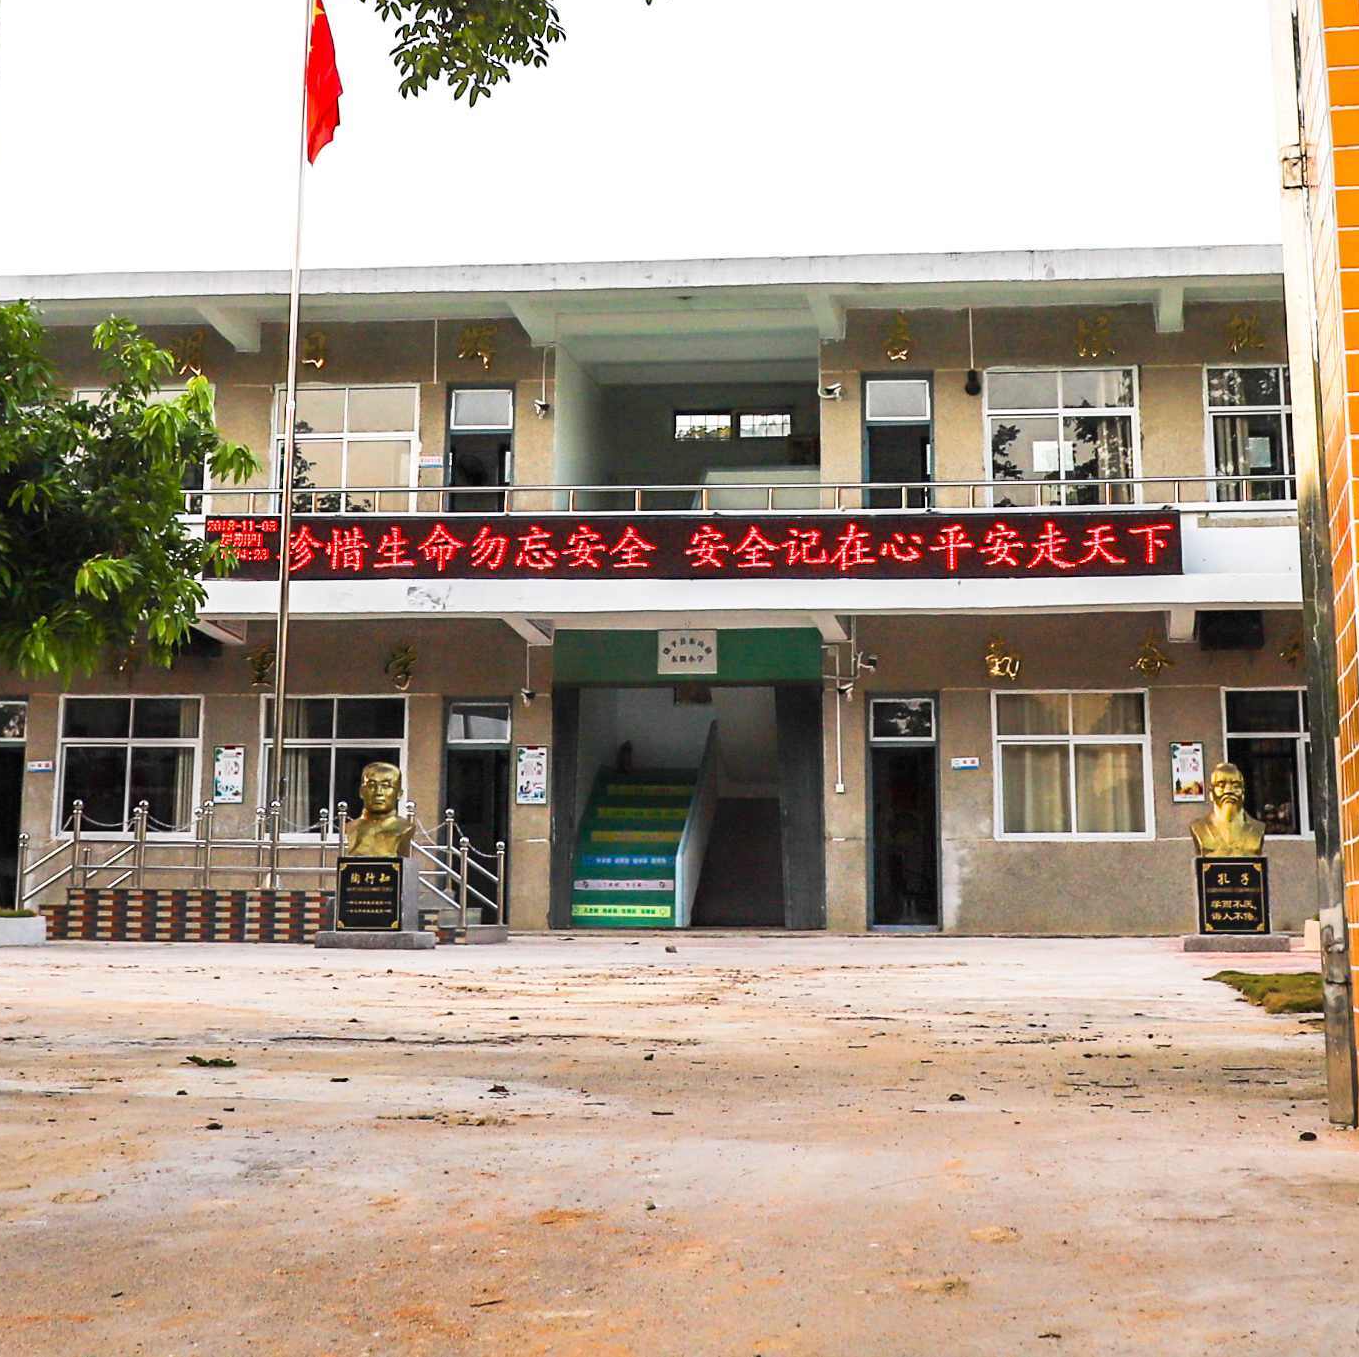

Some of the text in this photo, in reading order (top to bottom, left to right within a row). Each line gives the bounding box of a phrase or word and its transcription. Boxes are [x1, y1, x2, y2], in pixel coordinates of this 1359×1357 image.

[289, 522, 1175, 572] 珍惜生命勿忘安全 安全记在心平安走天下
